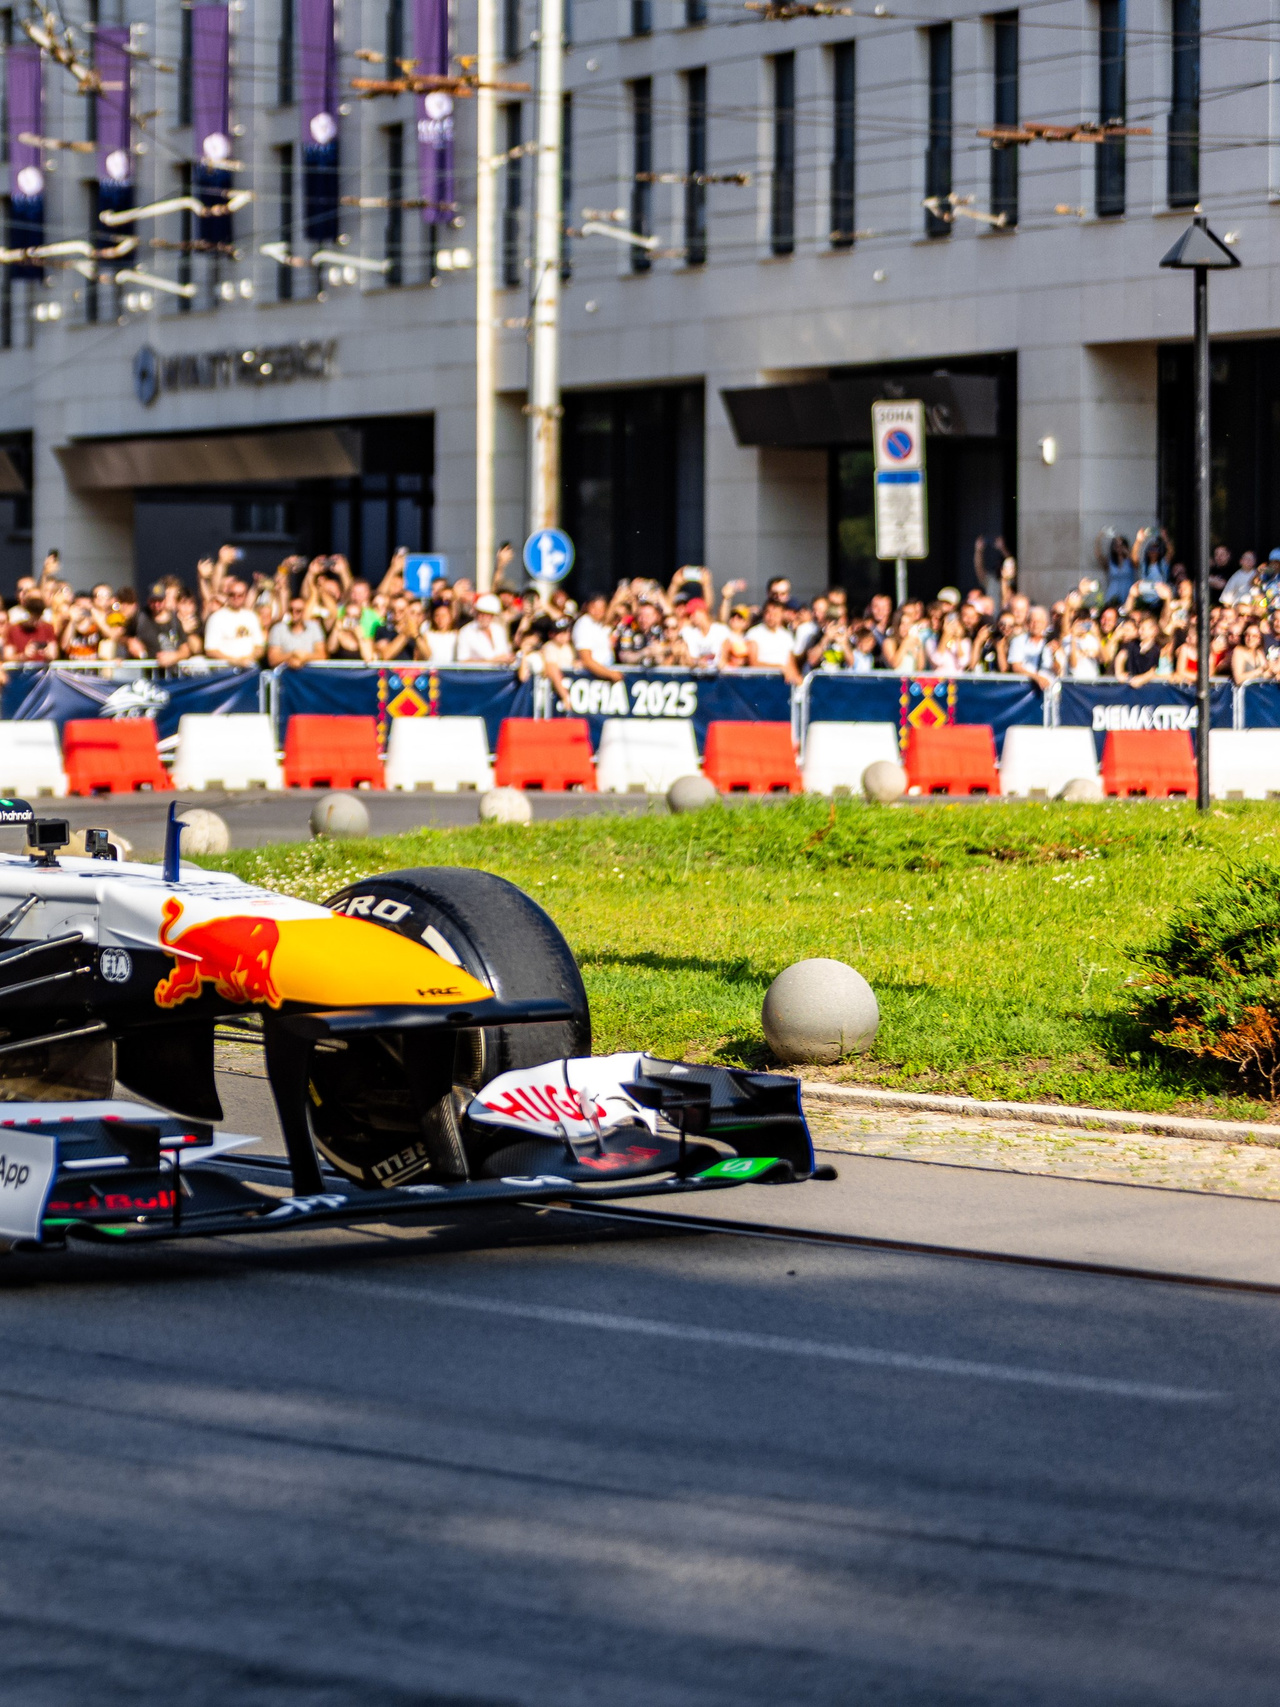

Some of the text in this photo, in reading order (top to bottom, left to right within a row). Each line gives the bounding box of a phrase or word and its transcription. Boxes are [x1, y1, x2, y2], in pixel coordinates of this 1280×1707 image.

[631, 679, 697, 717] 2025
[2, 810, 33, 821] hahnair
[102, 954, 128, 975] FIA
